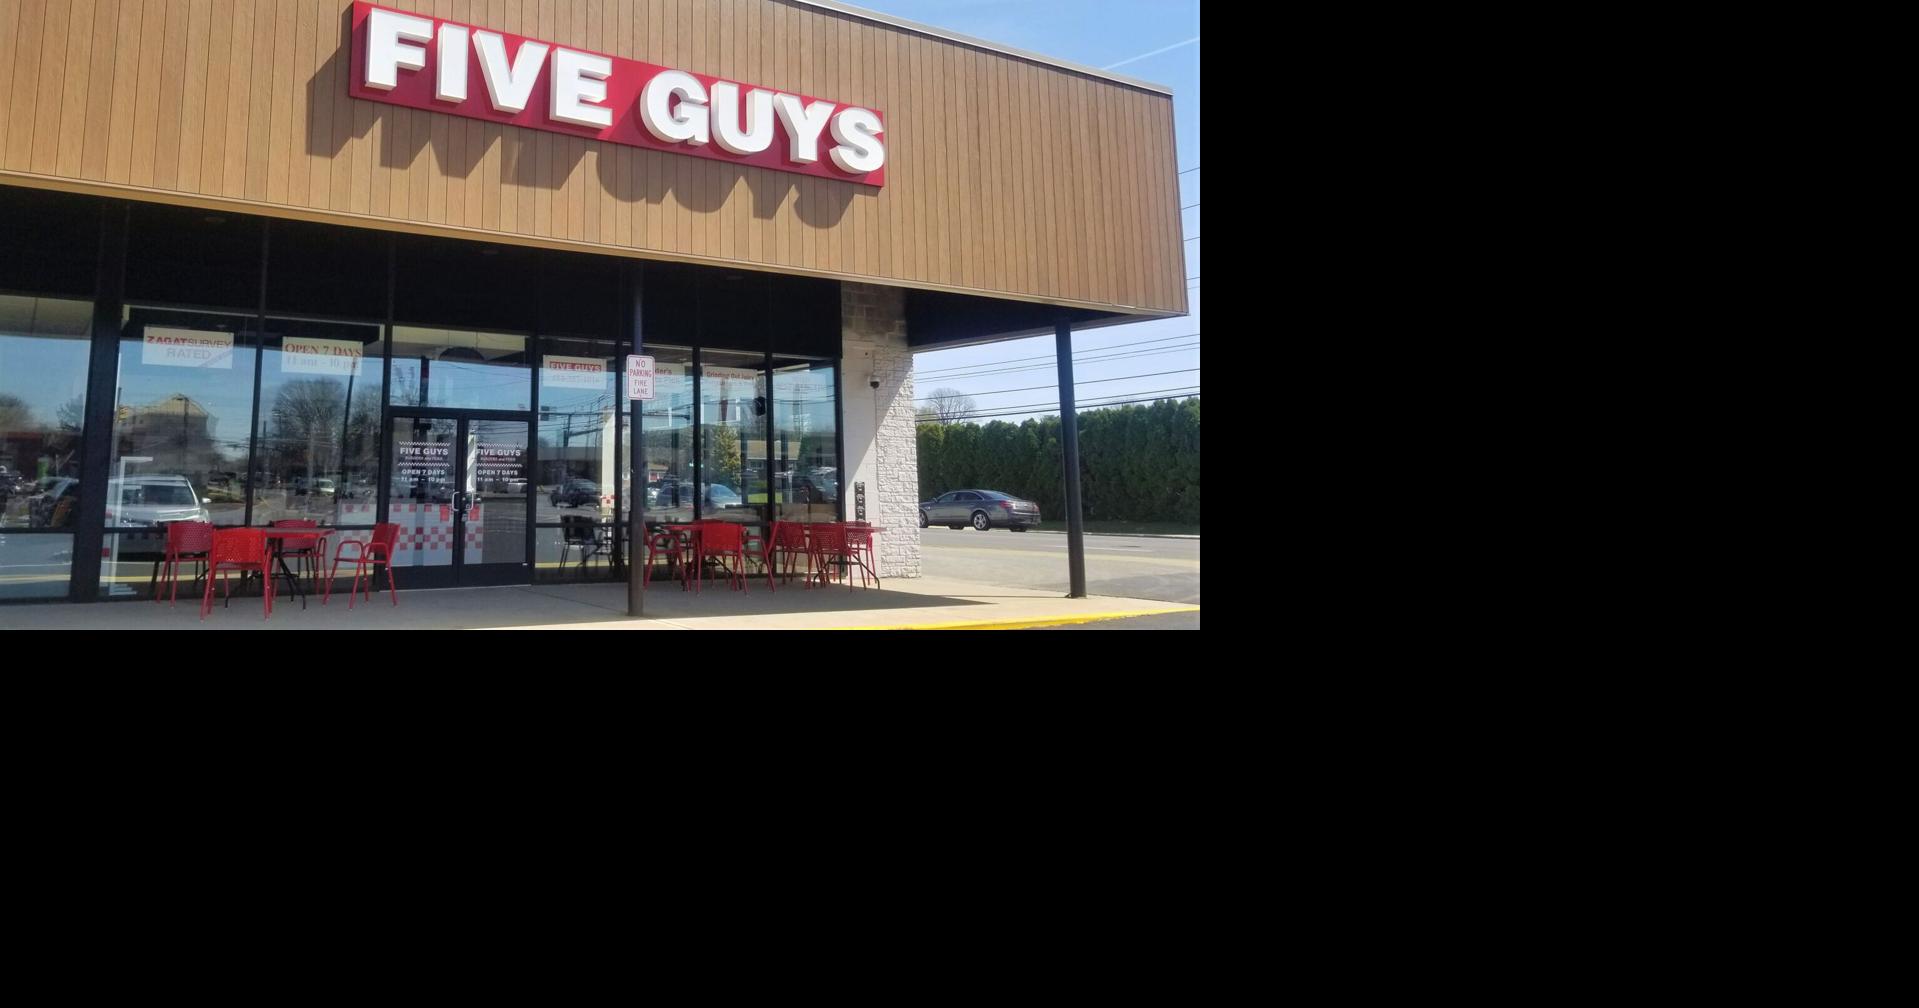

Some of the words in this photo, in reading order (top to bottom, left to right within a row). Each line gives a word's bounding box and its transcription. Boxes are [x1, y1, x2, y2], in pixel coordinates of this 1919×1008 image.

[364, 7, 613, 129] FIVE
[640, 69, 885, 174] GUYS
[166, 347, 212, 360] RATED
[285, 343, 319, 355] OPEN
[323, 346, 329, 355] 7
[334, 346, 361, 358] DAYS
[550, 362, 572, 370] FIVE
[574, 363, 601, 372] GUYS
[635, 360, 646, 368] NO
[629, 369, 652, 378] PARKING
[399, 447, 421, 455] FIVE
[423, 448, 448, 456] GUYS
[497, 449, 521, 457] GUYS
